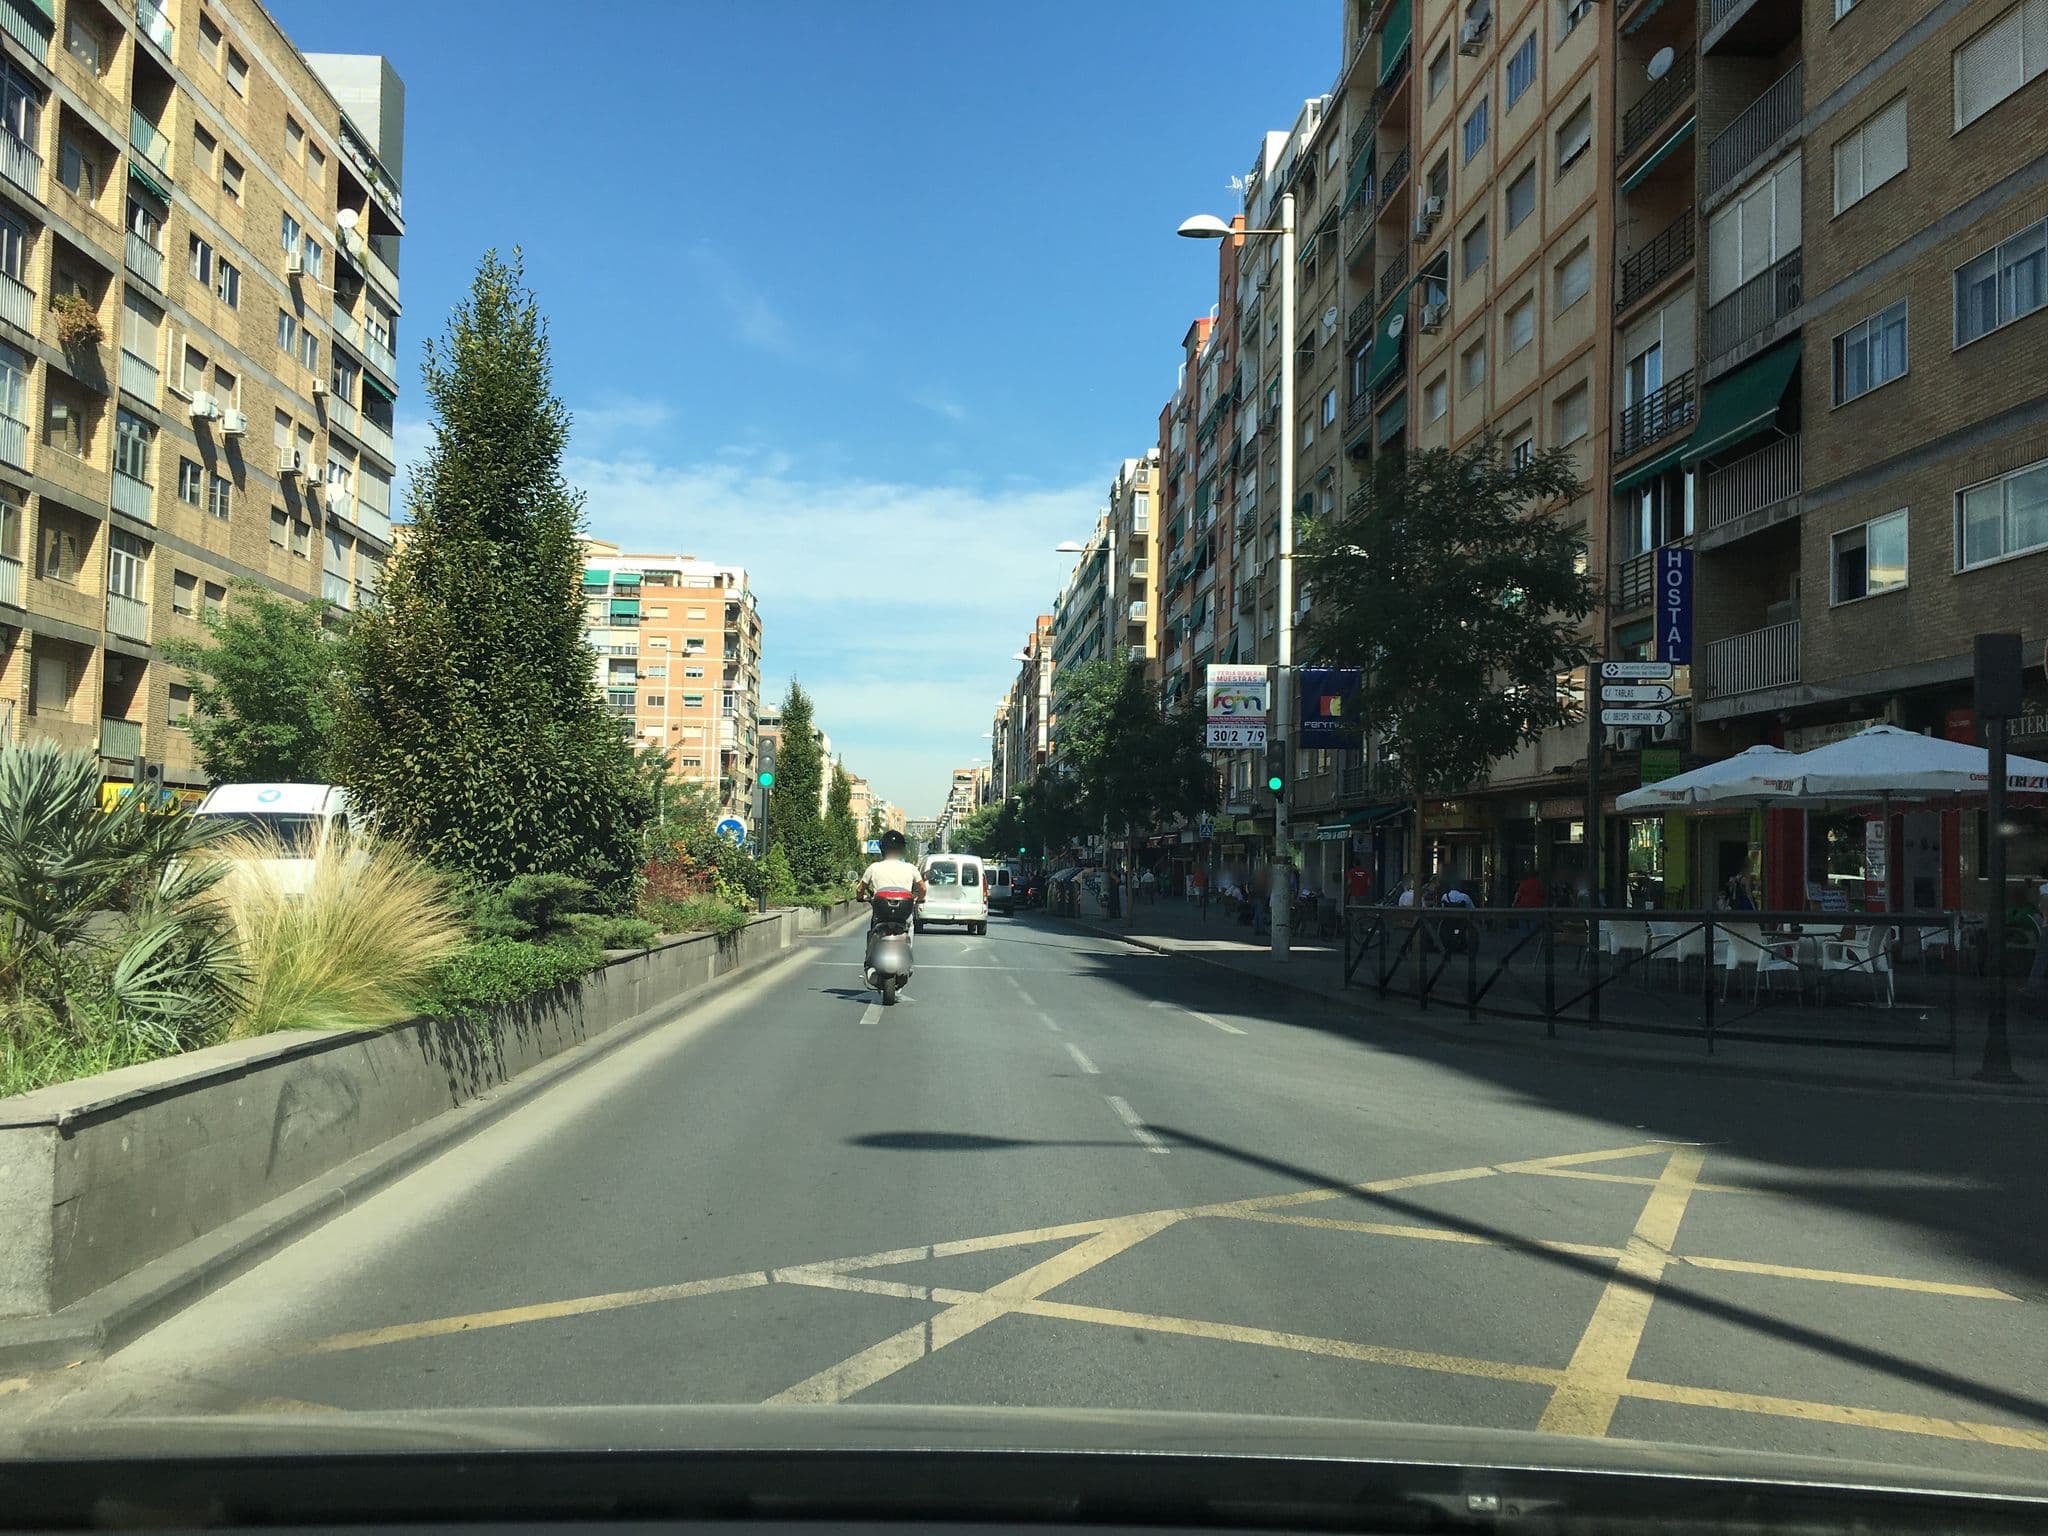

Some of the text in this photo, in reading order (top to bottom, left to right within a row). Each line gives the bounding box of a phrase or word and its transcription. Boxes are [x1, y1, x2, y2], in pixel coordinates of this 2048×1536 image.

[1667, 550, 1682, 662] HOSTAL
[1615, 689, 1634, 697] TABLAS
[1213, 731, 1265, 742] 30/2 7/9
